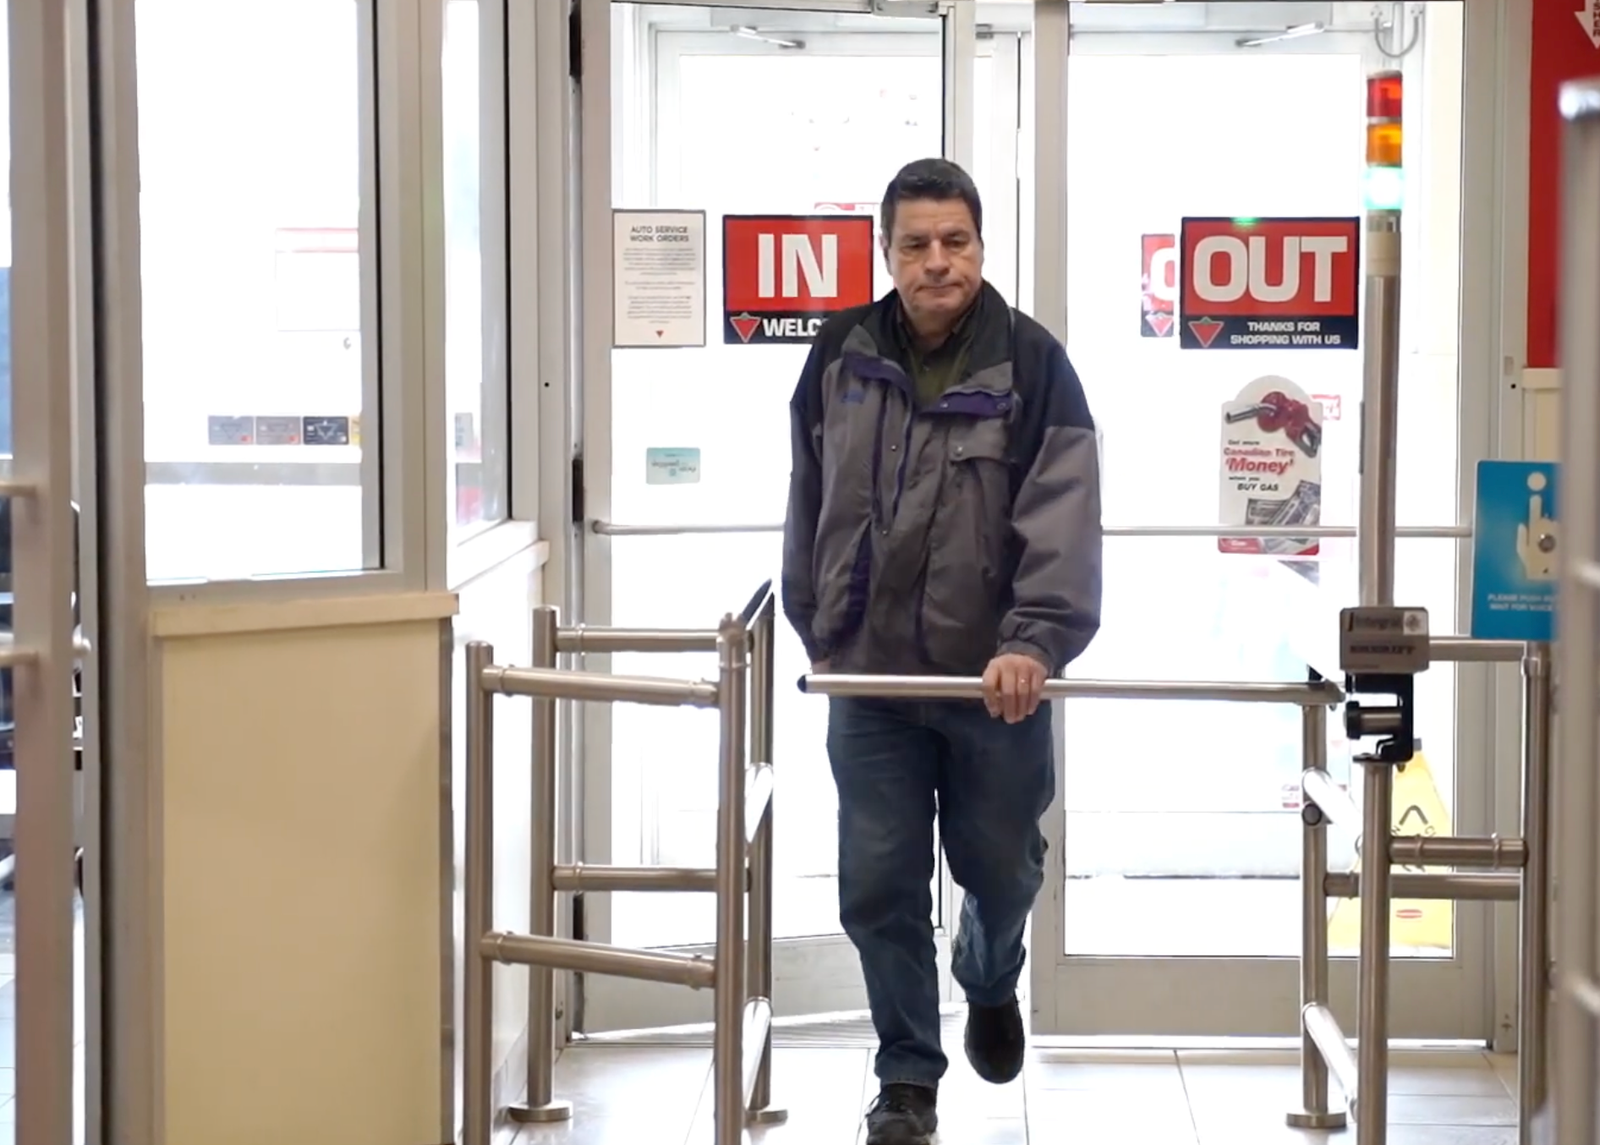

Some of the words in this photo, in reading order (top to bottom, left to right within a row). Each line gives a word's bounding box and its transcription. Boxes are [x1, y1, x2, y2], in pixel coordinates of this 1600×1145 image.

[631, 225, 653, 234] AUTO
[655, 225, 688, 234] SERVICE
[630, 234, 654, 243] WORK
[656, 234, 689, 243] ORDERS
[757, 233, 838, 298] IN
[1192, 235, 1348, 302] OUT
[762, 318, 823, 337] WELC
[1247, 321, 1295, 332] THANKS
[1297, 321, 1321, 332] FOR
[1230, 334, 1290, 345] SHOPPING
[1291, 334, 1322, 345] WITH
[1324, 334, 1341, 345] US
[1223, 447, 1272, 457] Canadian
[1275, 448, 1295, 458] Tire
[1237, 483, 1257, 491] BUY
[1260, 483, 1279, 491] GAS
